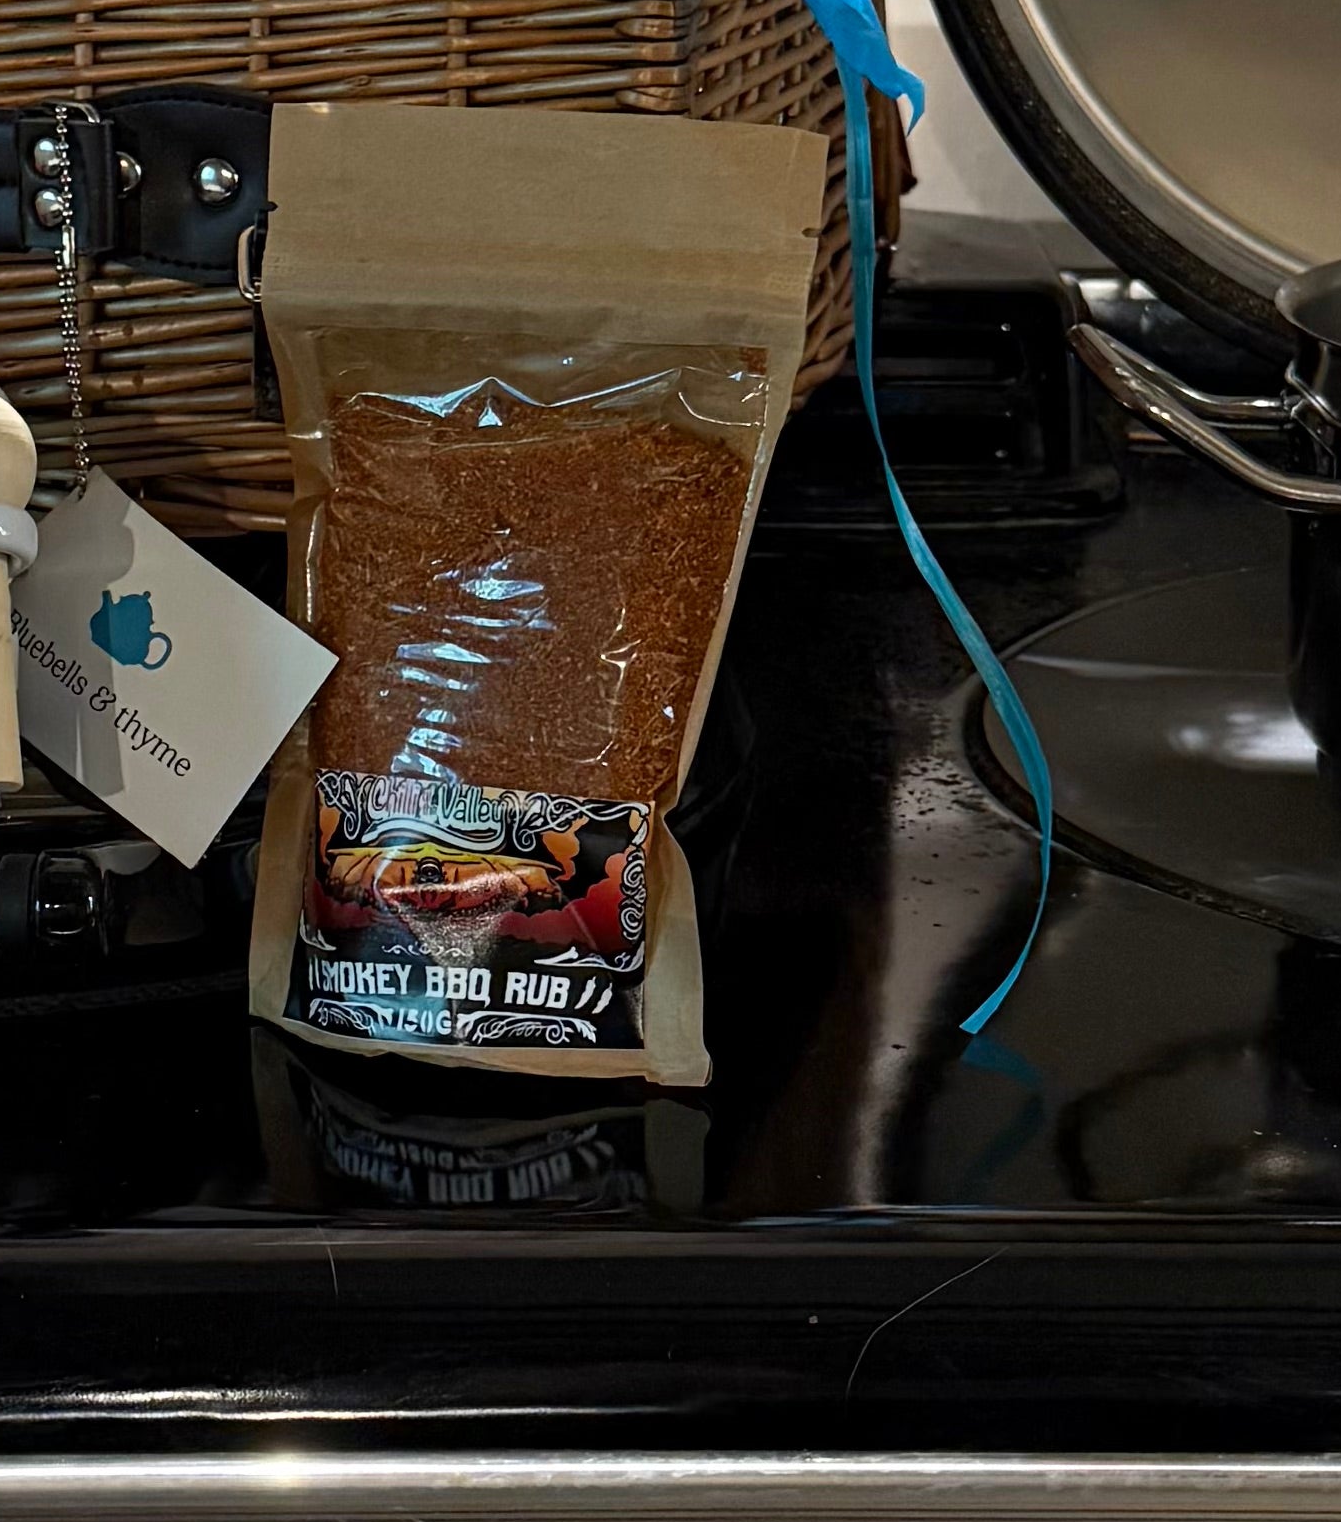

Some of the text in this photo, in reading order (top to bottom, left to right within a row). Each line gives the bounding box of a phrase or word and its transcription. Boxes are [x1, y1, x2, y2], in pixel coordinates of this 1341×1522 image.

[10, 608, 192, 778] Bluebells & thyme
[436, 785, 508, 841] Valley
[321, 959, 571, 1010] SMOKEY BBQ RUB
